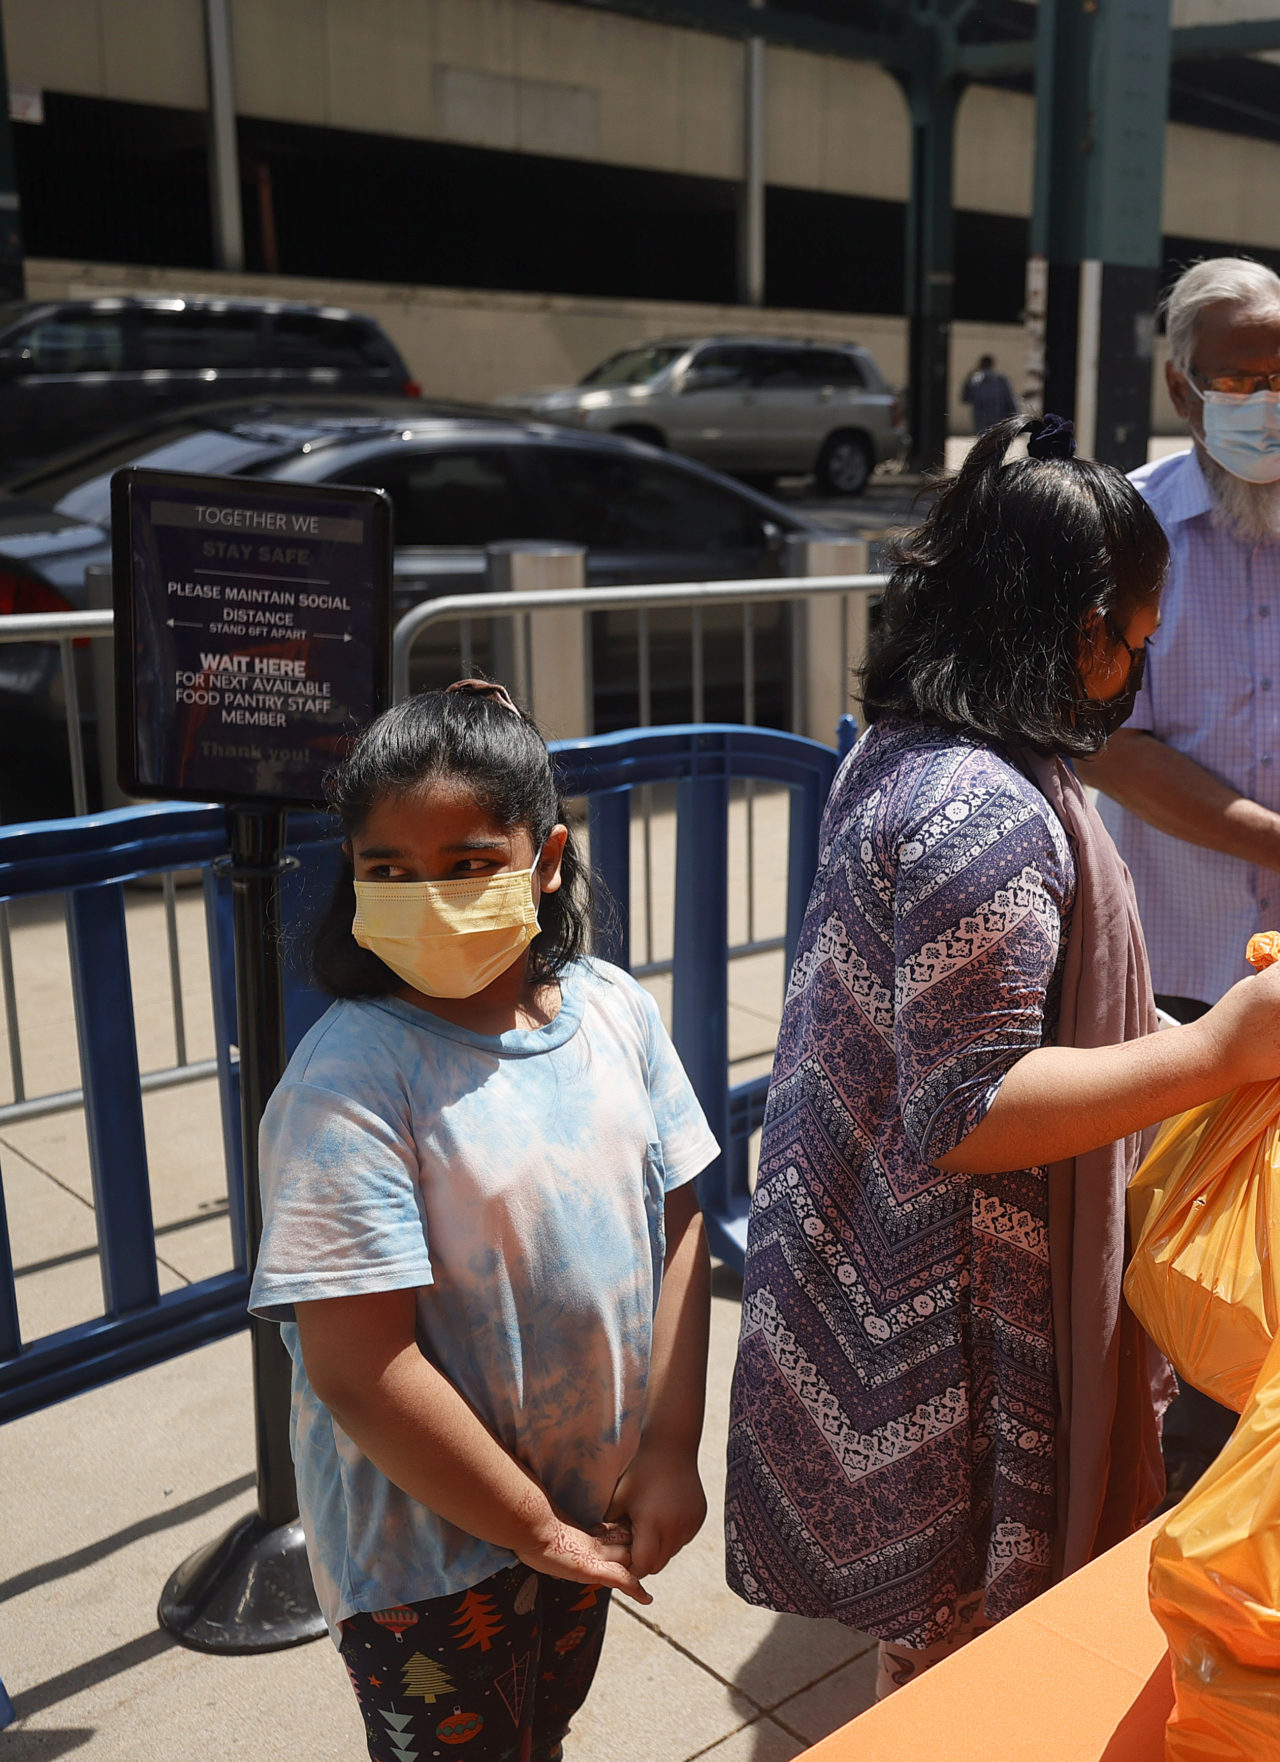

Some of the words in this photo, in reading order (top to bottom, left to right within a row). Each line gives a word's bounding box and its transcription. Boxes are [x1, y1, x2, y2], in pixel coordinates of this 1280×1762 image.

[196, 506, 286, 531] TOGETHER
[292, 515, 319, 533] WE
[203, 541, 251, 560] STAY
[258, 546, 310, 565] SAFE
[167, 581, 221, 600] PLEASE
[225, 587, 295, 606] MAINTAIN
[299, 594, 351, 611] SOCIAL
[223, 607, 294, 627] DISTANCE
[209, 622, 246, 634] STAND
[248, 625, 268, 637] 6FT
[270, 627, 307, 641] APART
[200, 652, 250, 673] WAIT
[254, 656, 306, 678] HERE
[175, 671, 205, 688] FOR
[209, 673, 248, 690] NEXT
[252, 677, 331, 697] AVAILABLE
[175, 688, 220, 706] FOOD
[225, 692, 284, 710] PANTRY
[288, 697, 331, 714] STAFF
[221, 709, 286, 728] MEMBER
